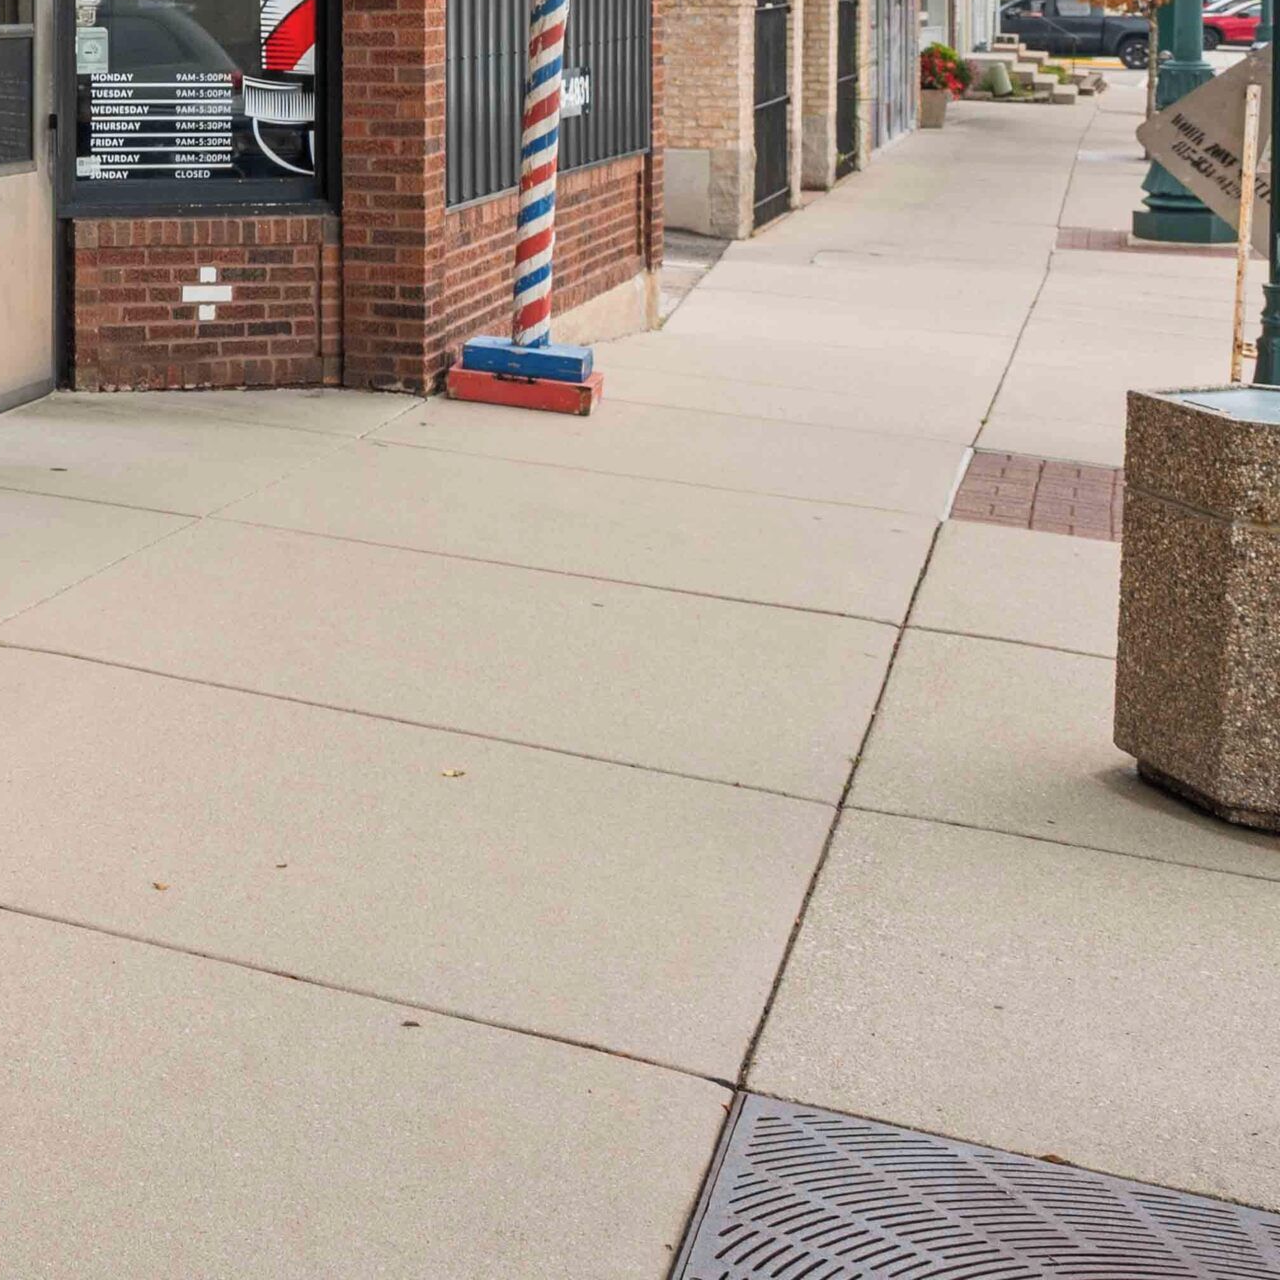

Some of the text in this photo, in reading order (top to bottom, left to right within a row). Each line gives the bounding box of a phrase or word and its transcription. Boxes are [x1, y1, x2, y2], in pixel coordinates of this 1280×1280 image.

[90, 73, 232, 82] MONDAY 9AM-5:00PM
[90, 89, 232, 98] TUESDAY 9AM-5:00PM
[90, 105, 149, 114] WEDNESDAY
[90, 122, 232, 131] THURSDAY 9AM-5:30PM
[90, 138, 232, 147] FRIDAY 9AM-5:30PM
[175, 154, 232, 162] 8AM-2:00PM
[175, 170, 211, 179] CLOSED
